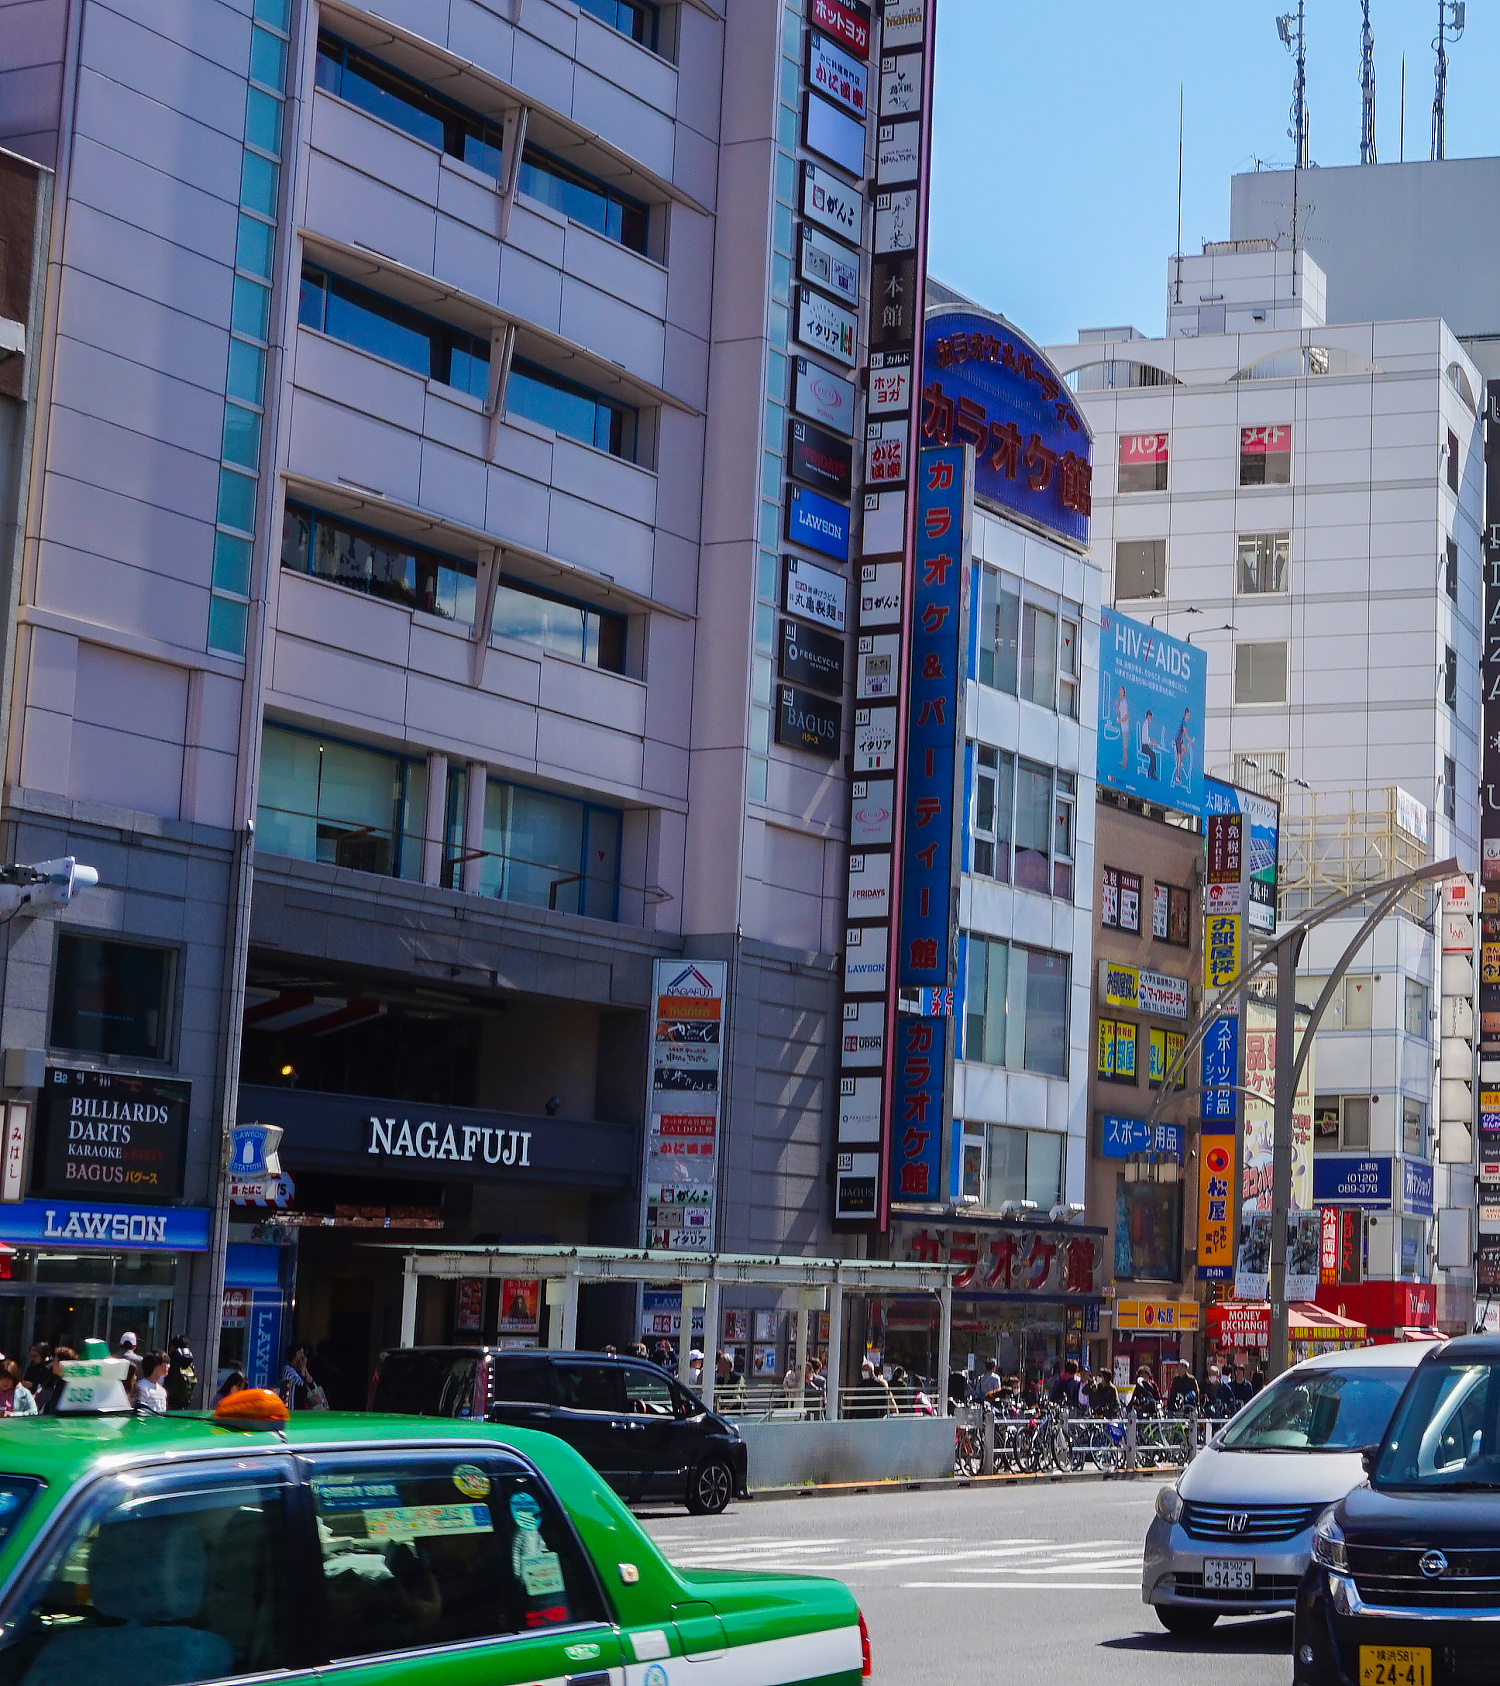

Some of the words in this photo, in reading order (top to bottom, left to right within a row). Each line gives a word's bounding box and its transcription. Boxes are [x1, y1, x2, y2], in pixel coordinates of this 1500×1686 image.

[815, 0, 867, 46] ホットヨガ
[826, 196, 856, 228] がんこ
[882, 275, 905, 328] 本館
[806, 320, 841, 346] イタリア
[886, 353, 910, 366] カルド
[873, 374, 906, 391] ホット
[876, 387, 900, 403] ヨガ
[923, 380, 1093, 517] カラオケ館
[1130, 433, 1169, 454] ハウス
[1244, 427, 1285, 449] メイト
[798, 510, 842, 539] LAWSON
[795, 595, 837, 621] 丸亀製麺
[786, 705, 836, 740] BAGUS
[909, 459, 954, 970] カラオケ&パーティー館
[858, 737, 893, 755] イタリア
[1215, 817, 1223, 839] TAX
[1214, 840, 1223, 871] FREE
[1227, 826, 1240, 869] 免税店
[1210, 917, 1235, 987] お部屋探し
[847, 962, 886, 975] LAWSON
[666, 986, 714, 997] NAGAFUJI
[1146, 987, 1187, 1007] マイルドシティ
[858, 1038, 882, 1049] UDON
[54, 1071, 68, 1084] B2
[1217, 1019, 1232, 1115] スポーツ用品
[70, 1097, 169, 1125] BILLIARDS
[900, 1022, 933, 1194] カラオケ館
[68, 1120, 132, 1145] DARTS
[368, 1116, 532, 1167] NAGAFUJI
[1108, 1116, 1178, 1152] スポーツ用品
[9, 1126, 22, 1181] みはし
[67, 1143, 123, 1160] KARAOKE
[65, 1161, 124, 1184] BAGUS
[125, 1170, 159, 1185] バグース
[231, 1160, 264, 1172] STATION
[1346, 1173, 1379, 1184] (0120)
[840, 1186, 874, 1199] BAGUS
[1206, 1175, 1229, 1222] 松屋
[43, 1210, 169, 1243] LAWSON
[1321, 1207, 1337, 1269] 外貨両替
[672, 1235, 707, 1246] イタリア
[910, 1227, 1097, 1294] カラオケ館
[1206, 1268, 1225, 1278] 24h
[1156, 1306, 1174, 1325] 松屋
[1221, 1320, 1268, 1331] EXCHANGE
[1228, 1310, 1262, 1321] MONEY
[1221, 1332, 1269, 1347] 外貨両替
[1214, 1570, 1252, 1589] 94-59
[1375, 1664, 1425, 1686] 24-41
